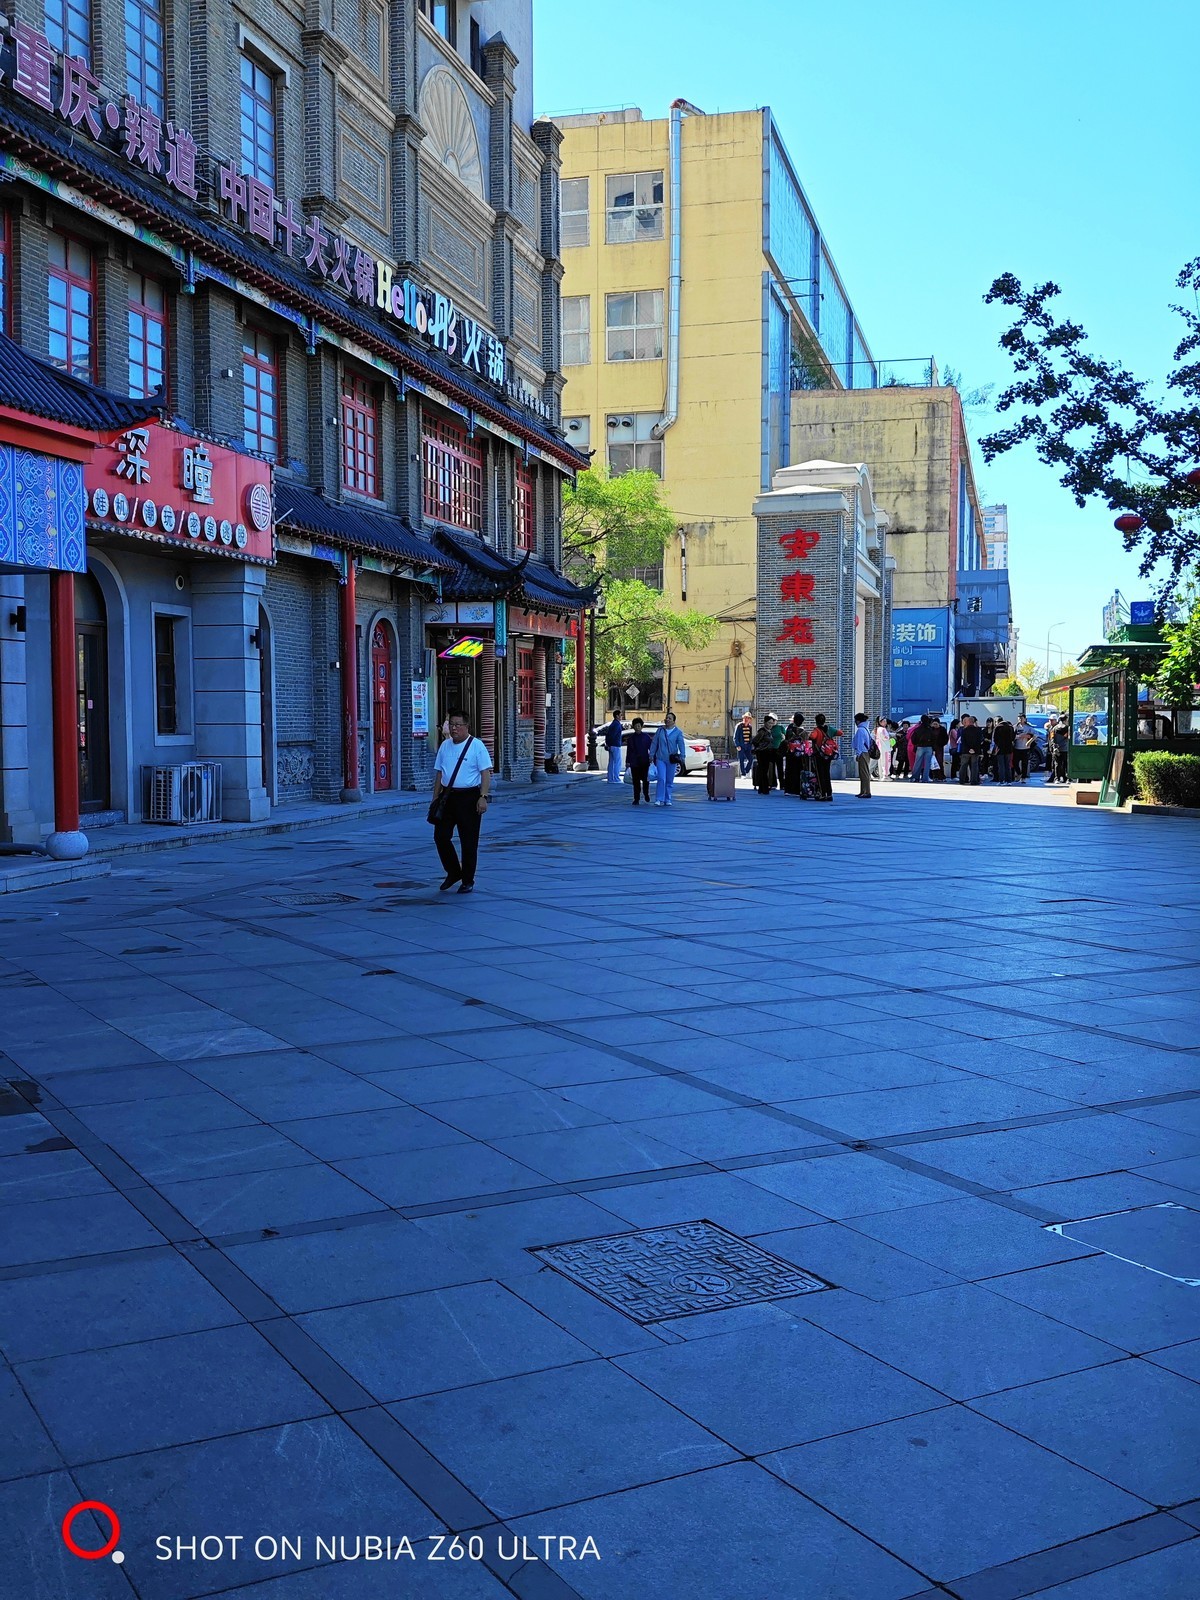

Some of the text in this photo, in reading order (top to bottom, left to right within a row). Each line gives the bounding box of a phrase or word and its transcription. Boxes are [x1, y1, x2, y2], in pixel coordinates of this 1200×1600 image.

[0, 19, 375, 307] 重庆·辣道 中国十大火锅
[377, 261, 428, 333] Hello
[116, 427, 214, 505] 深瞳
[80, 485, 248, 549] 娃机/潮玩/密室逃脱
